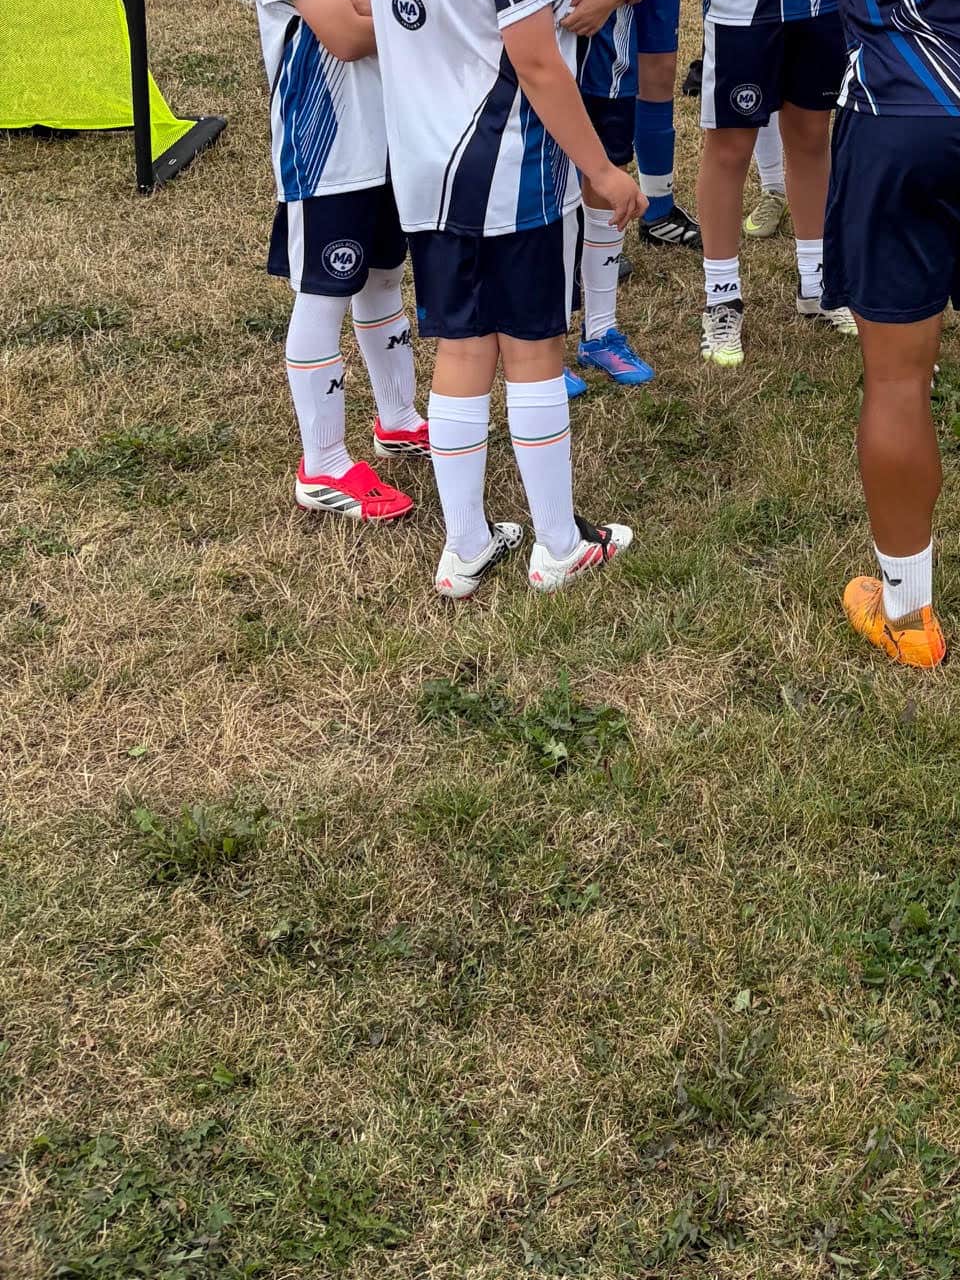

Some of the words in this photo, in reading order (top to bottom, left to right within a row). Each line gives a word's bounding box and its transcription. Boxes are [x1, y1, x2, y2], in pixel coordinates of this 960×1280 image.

[400, 0, 418, 17] MA
[332, 252, 353, 265] MA
[713, 282, 738, 293] MA
